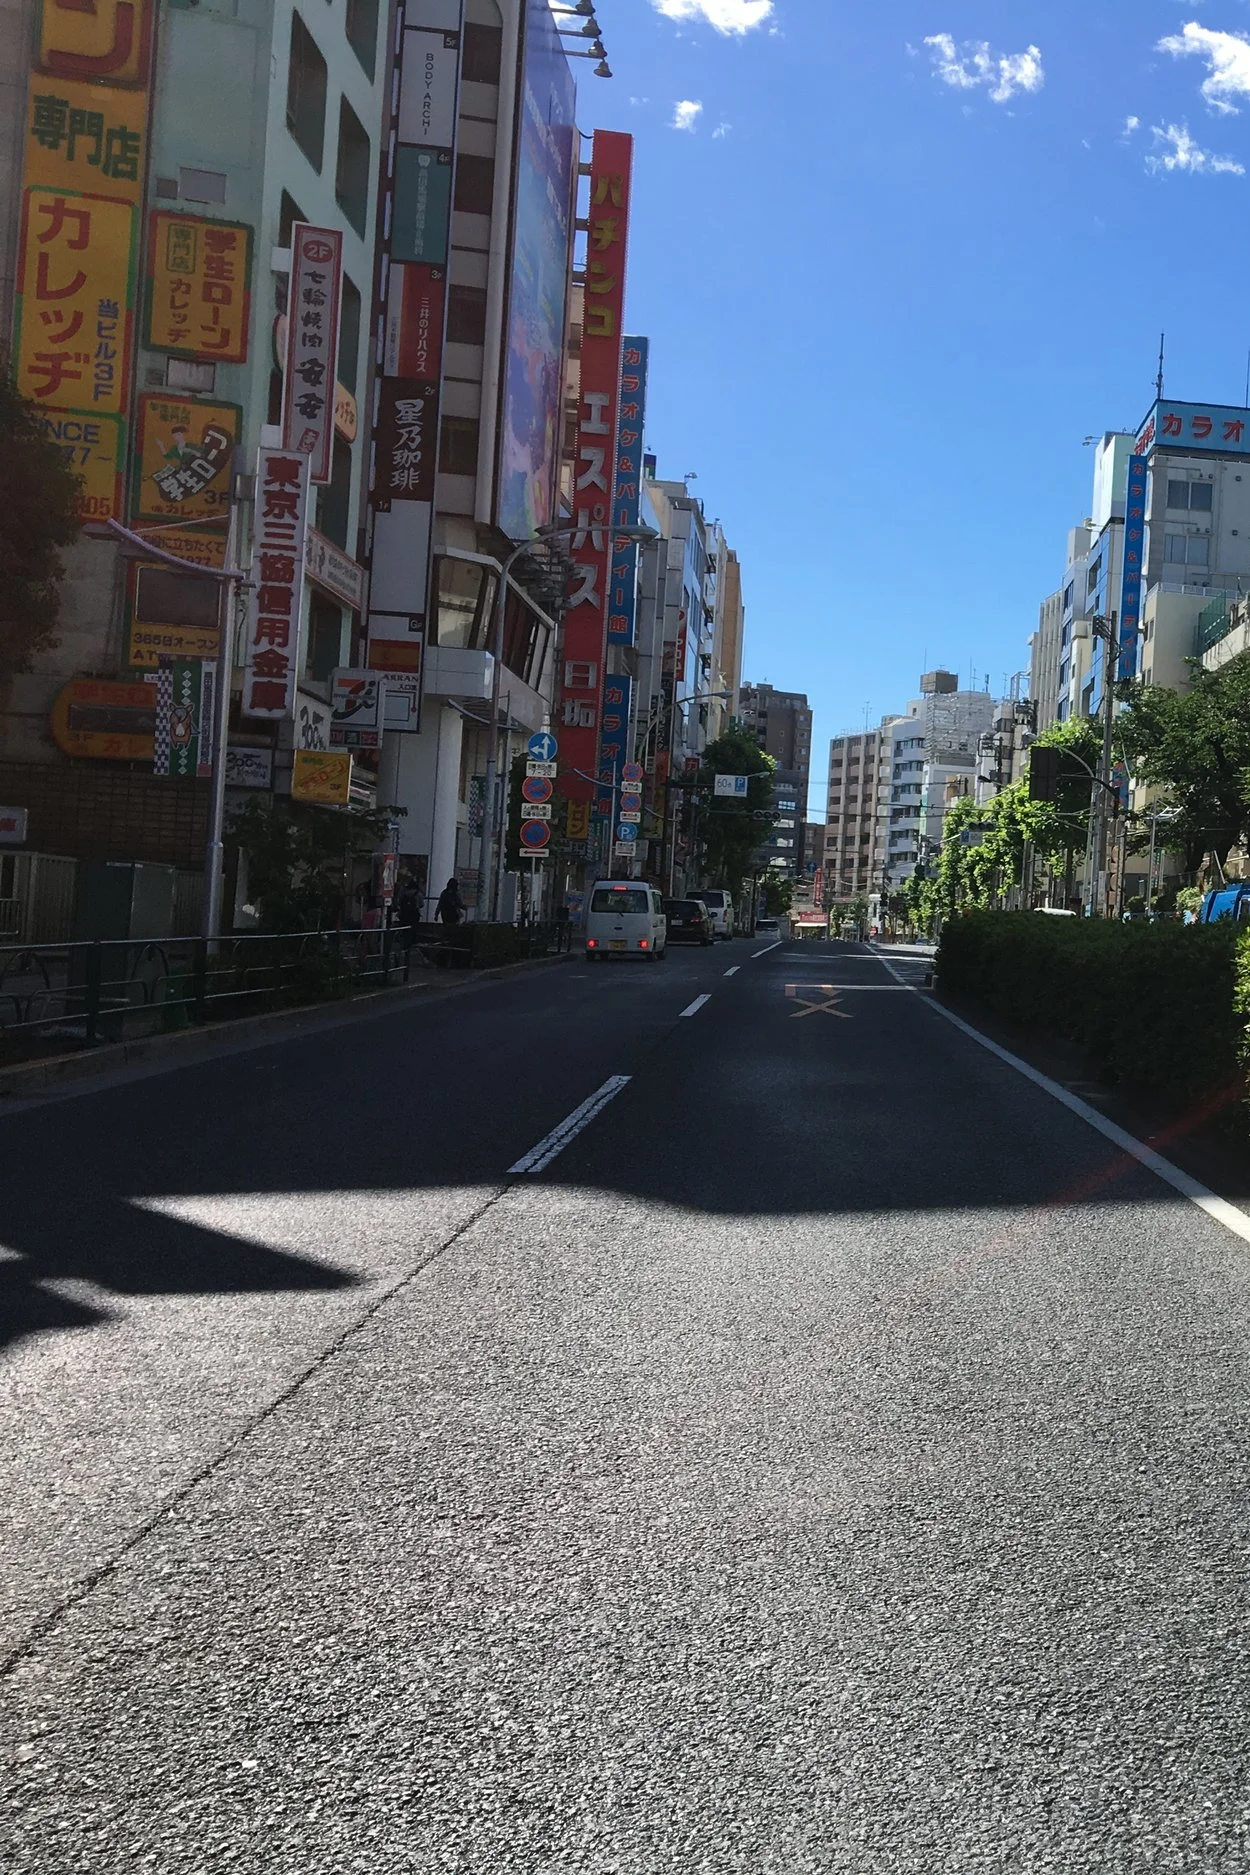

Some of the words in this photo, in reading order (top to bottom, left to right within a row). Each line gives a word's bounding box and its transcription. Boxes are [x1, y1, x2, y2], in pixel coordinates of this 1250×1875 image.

[424, 53, 434, 89] BODY
[32, 94, 141, 181] 専門店
[422, 92, 432, 135] ARCHI
[307, 245, 330, 259] 2F
[431, 269, 442, 279] 3F
[585, 173, 624, 337] パチンコ
[200, 229, 237, 349] 学生ローン
[93, 299, 120, 402] 当ビル3F
[416, 297, 430, 372] 三井のリハウス
[294, 357, 327, 420] 安安
[424, 386, 435, 396] 2F
[389, 398, 425, 491] 星乃珈琲
[570, 391, 610, 608] エスパス
[608, 347, 642, 633] カラオケ&パーティー館
[251, 456, 303, 713] 東京三協信用金庫
[133, 632, 218, 650] 365日オープン
[383, 673, 419, 682] ARRAN
[563, 659, 598, 728] 日拓
